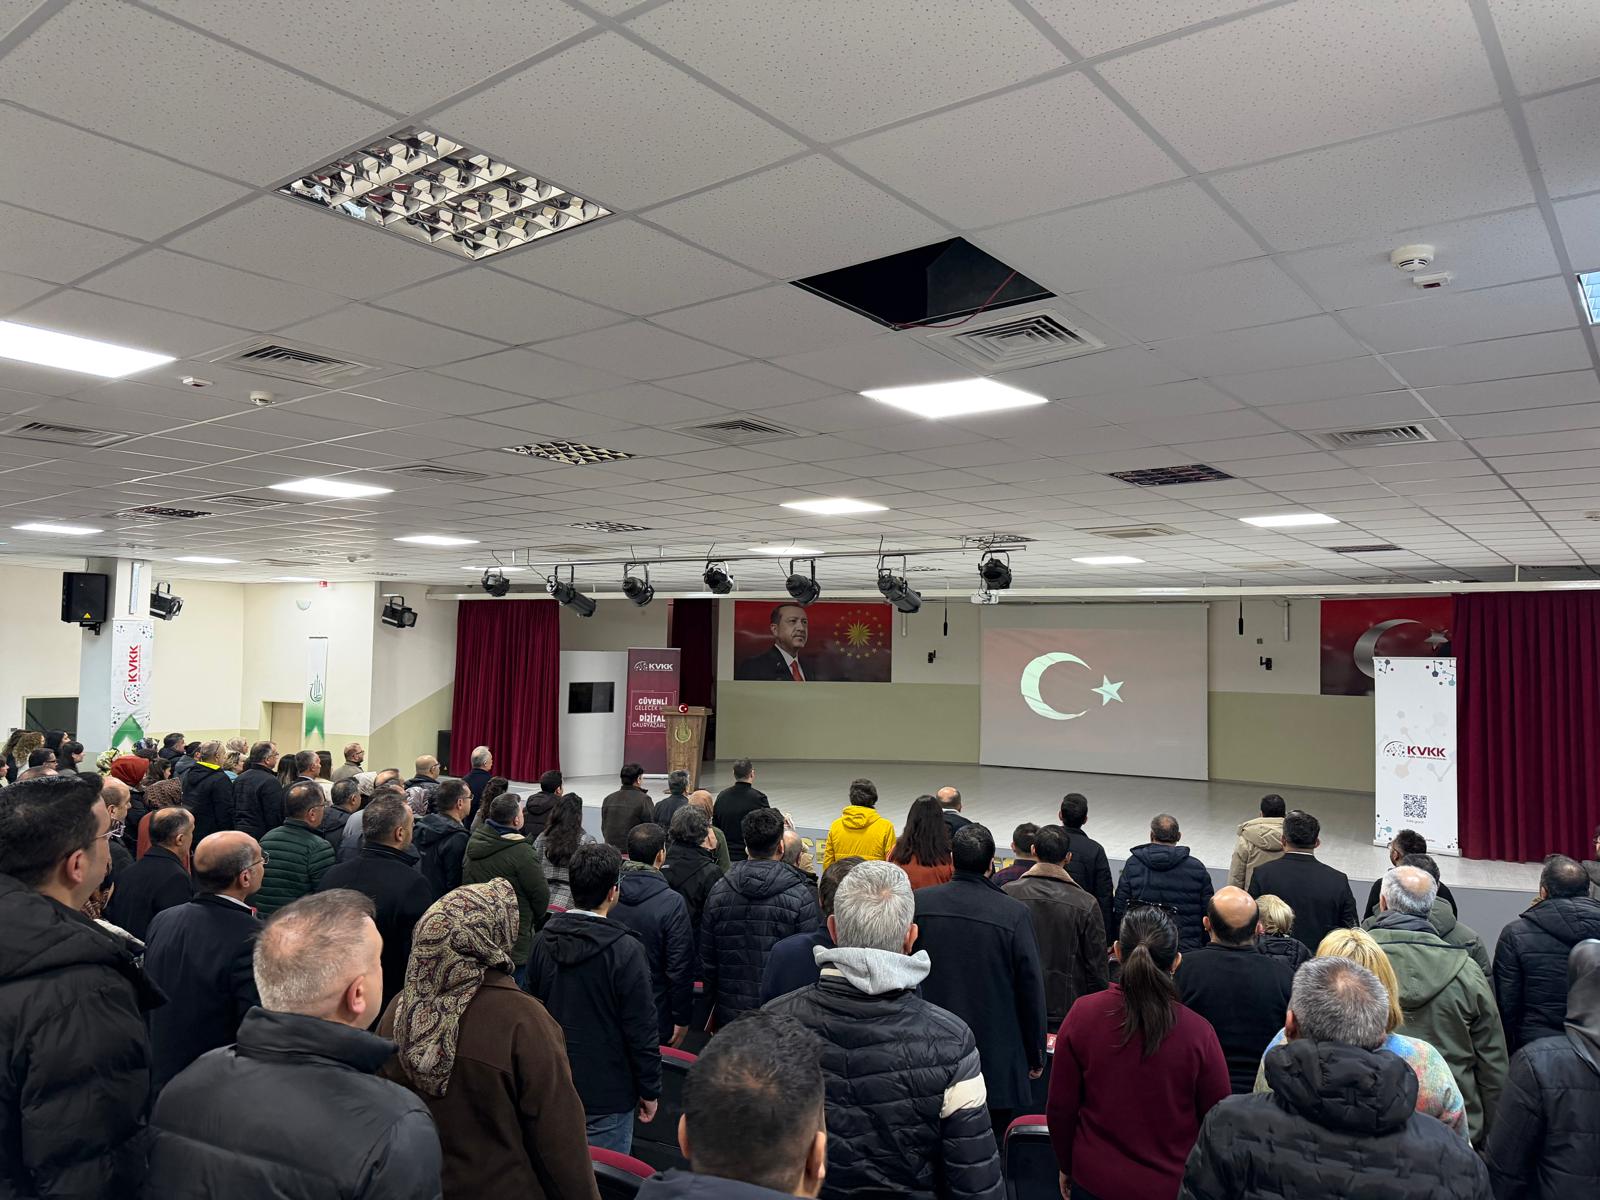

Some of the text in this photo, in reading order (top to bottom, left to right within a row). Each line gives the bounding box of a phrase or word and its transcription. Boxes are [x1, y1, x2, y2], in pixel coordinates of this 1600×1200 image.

[128, 645, 138, 682] KVKK
[638, 696, 668, 705] GÜVENLİ
[1407, 745, 1446, 758] KVKK
